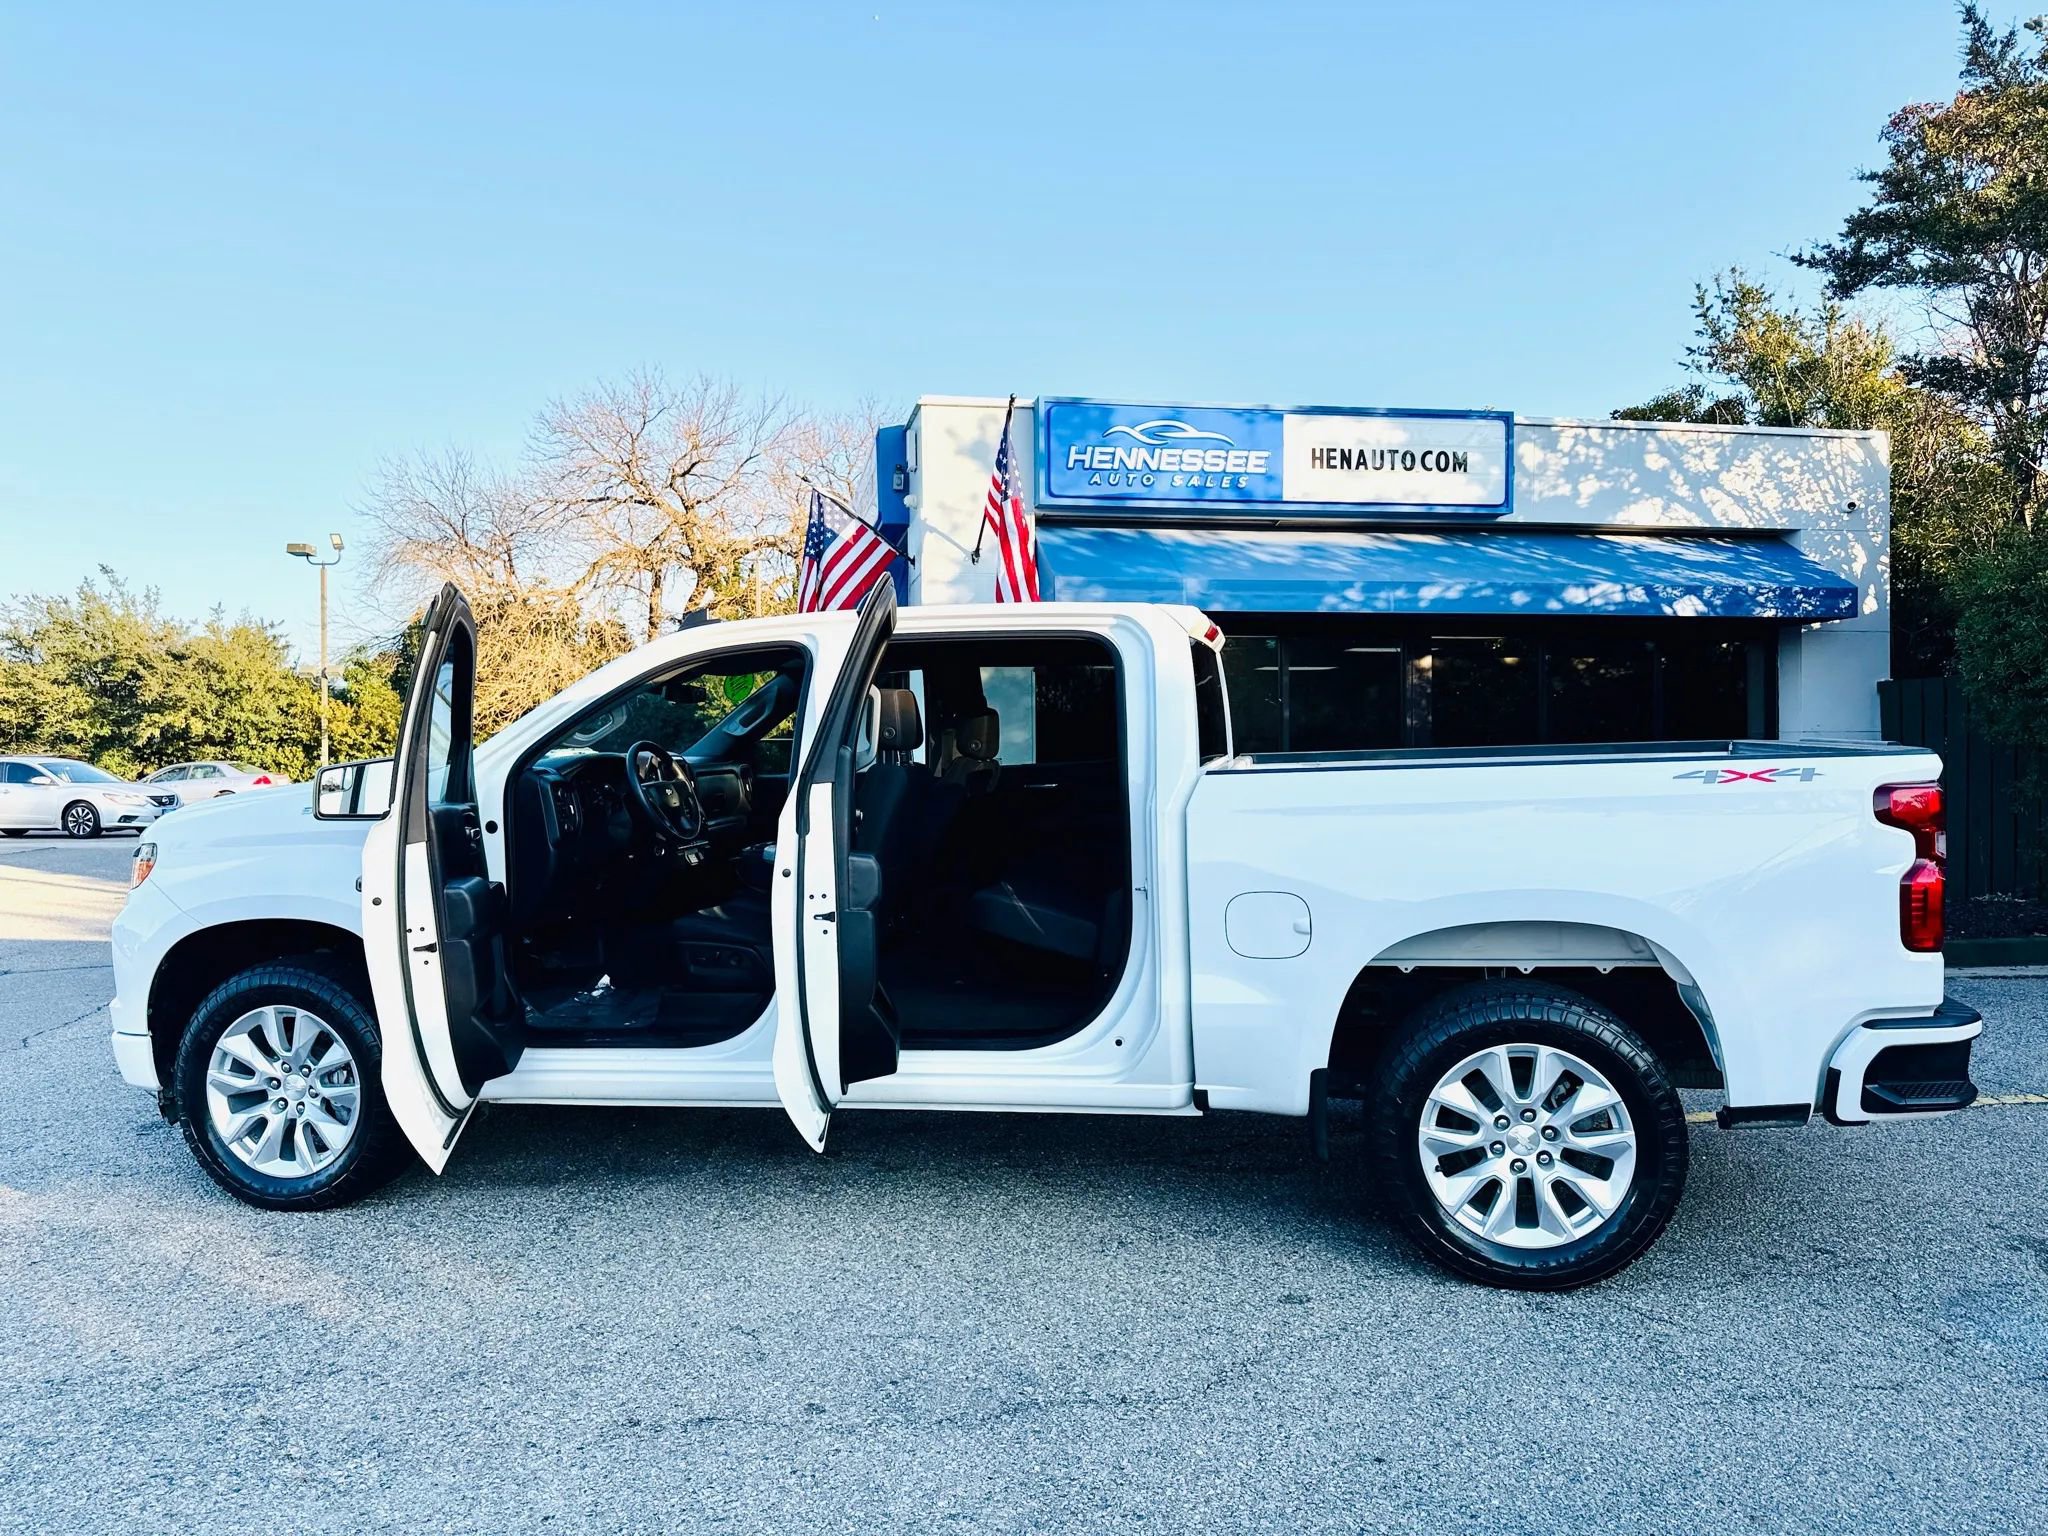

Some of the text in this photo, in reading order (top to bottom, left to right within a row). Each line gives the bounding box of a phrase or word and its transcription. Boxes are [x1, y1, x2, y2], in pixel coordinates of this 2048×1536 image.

[1067, 445, 1271, 474] HENNESSEE
[1089, 472, 1250, 489] AUTO SALES
